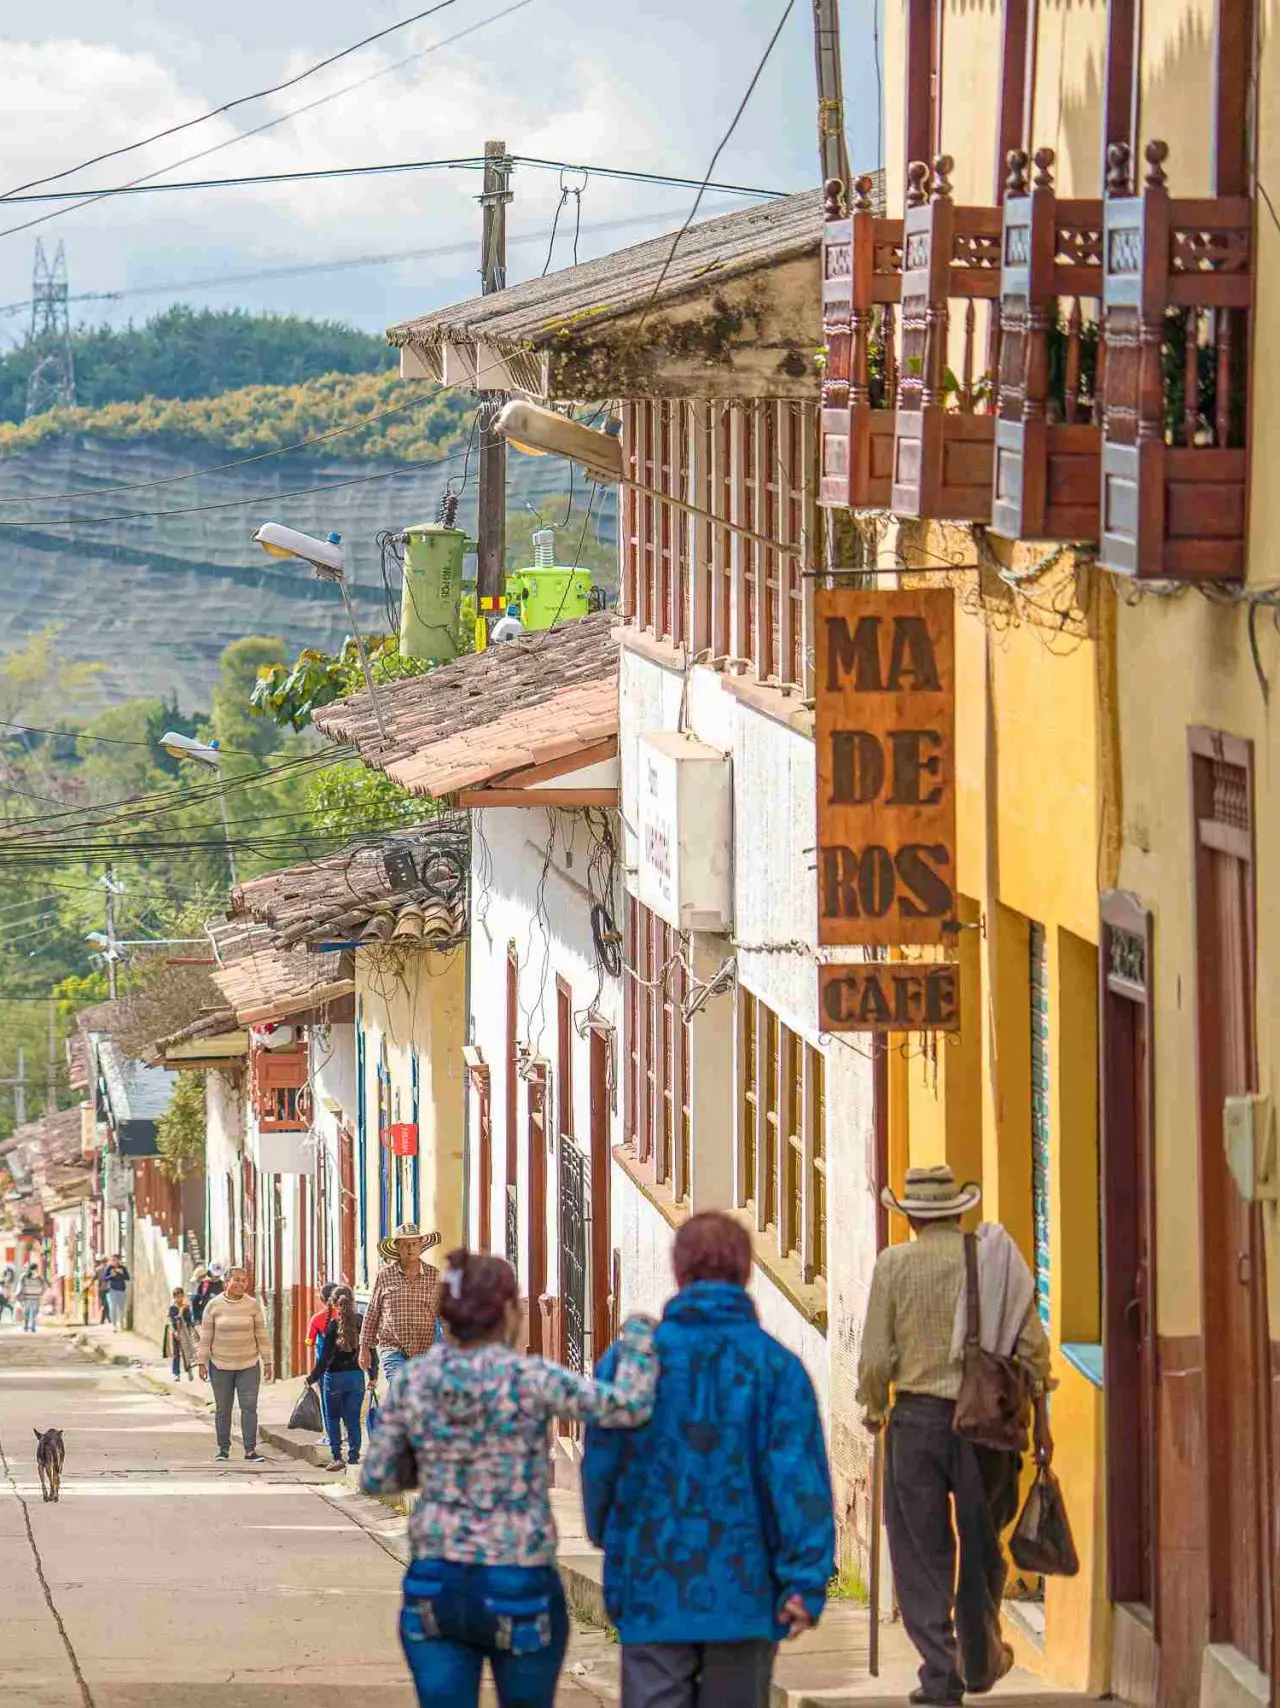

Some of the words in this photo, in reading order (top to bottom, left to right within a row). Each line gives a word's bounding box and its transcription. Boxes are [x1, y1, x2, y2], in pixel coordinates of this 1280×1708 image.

[825, 616, 943, 691] MA
[828, 730, 943, 804] DE
[821, 843, 954, 918] ROS
[823, 966, 955, 1023] CAFÉ
